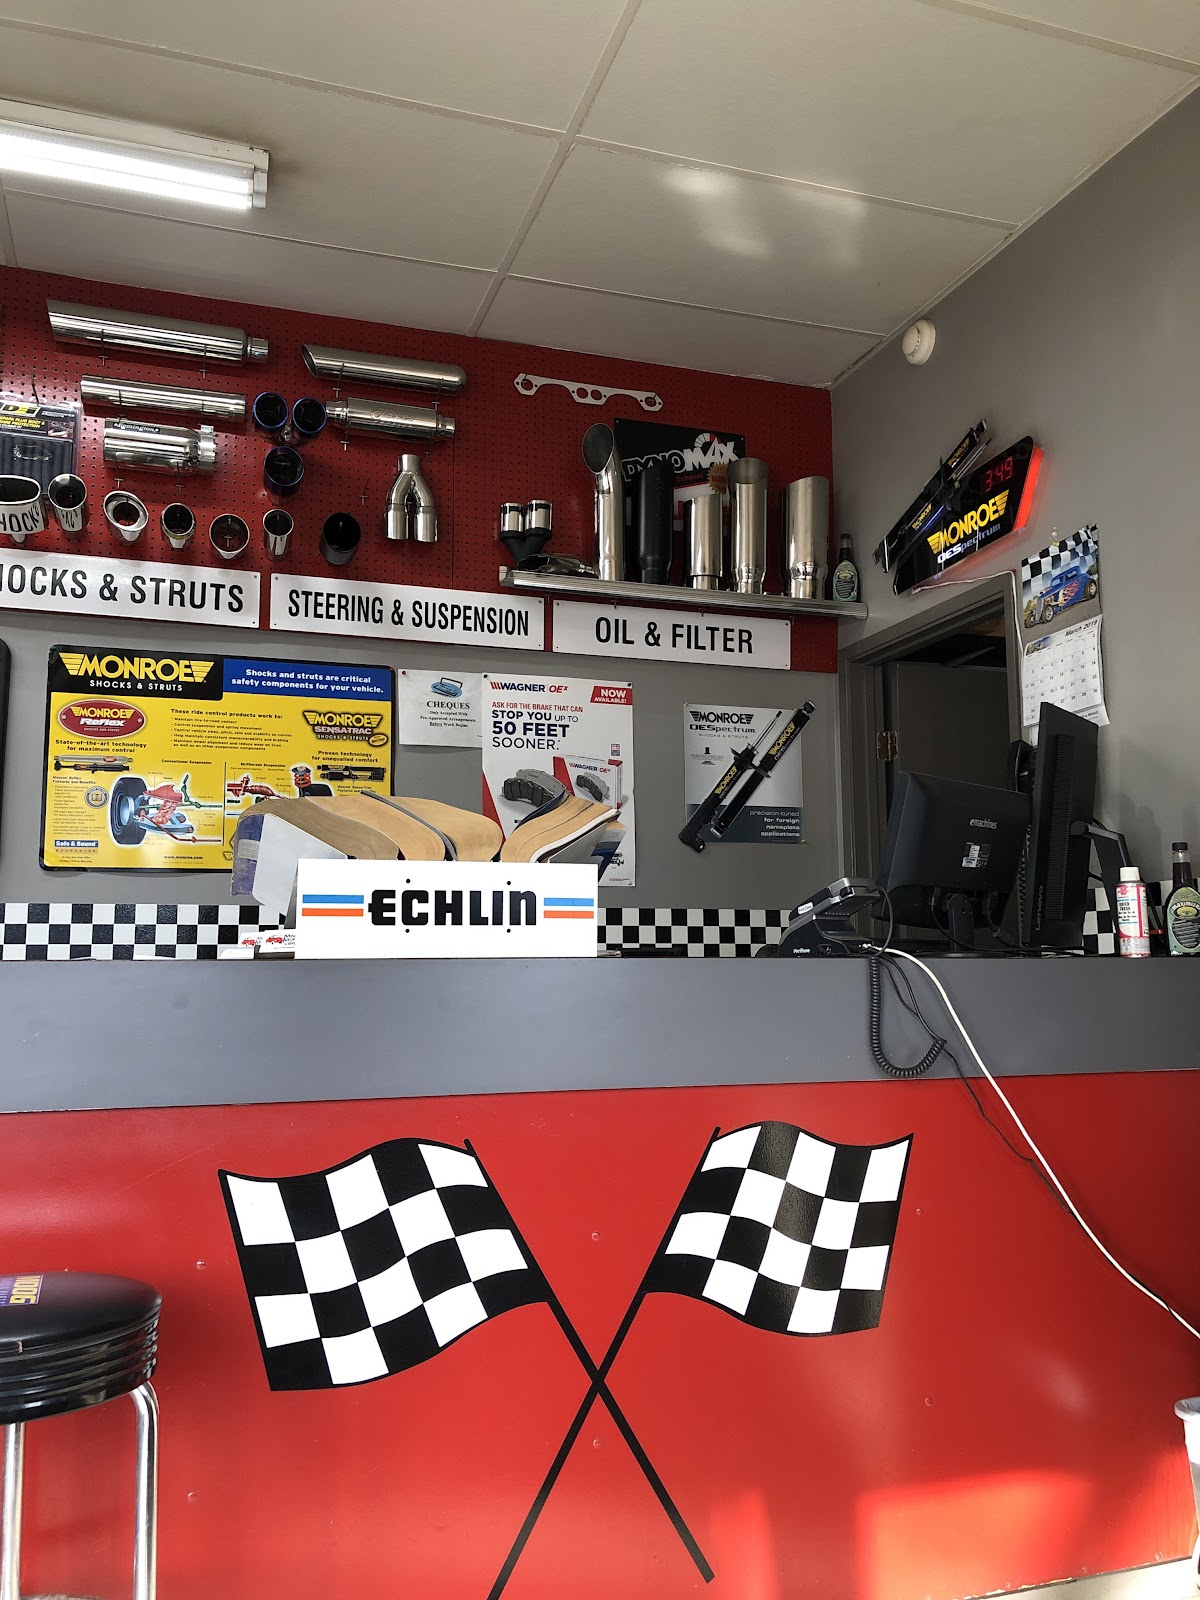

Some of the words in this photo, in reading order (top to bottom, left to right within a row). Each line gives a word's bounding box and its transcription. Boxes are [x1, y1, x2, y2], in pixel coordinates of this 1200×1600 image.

[984, 457, 1013, 493] 3:49
[933, 493, 1005, 551] MONROE
[0, 563, 87, 599] OCKS
[99, 573, 118, 601] &
[130, 575, 244, 613] STRUTS
[288, 589, 384, 625] STEERING
[390, 601, 404, 627] &
[412, 601, 529, 636] SUSPENSION
[596, 616, 634, 644] OIL
[644, 622, 661, 647] &
[672, 623, 753, 654] FILTER
[1065, 626, 1082, 636] March
[67, 653, 206, 682] MONROE
[246, 669, 277, 678] Shocks
[296, 673, 324, 681] struts
[90, 680, 132, 690] SHOCKS
[148, 682, 182, 692] STRUTS
[232, 678, 260, 688] safety
[262, 680, 314, 690] components
[352, 685, 384, 694] vehicle.
[498, 682, 546, 692] WAGNER
[600, 688, 626, 698] NOW
[74, 706, 131, 718] MONROE
[427, 701, 470, 710] CHEQUES
[309, 712, 377, 728] MONROE
[492, 710, 523, 720] STOP
[526, 711, 552, 720] YOU
[694, 711, 750, 724] MONROE
[492, 721, 517, 736] 50
[522, 723, 570, 737] FEET
[769, 722, 794, 754] MONROE
[572, 763, 598, 772] WAGNER
[715, 766, 737, 794] MONROE
